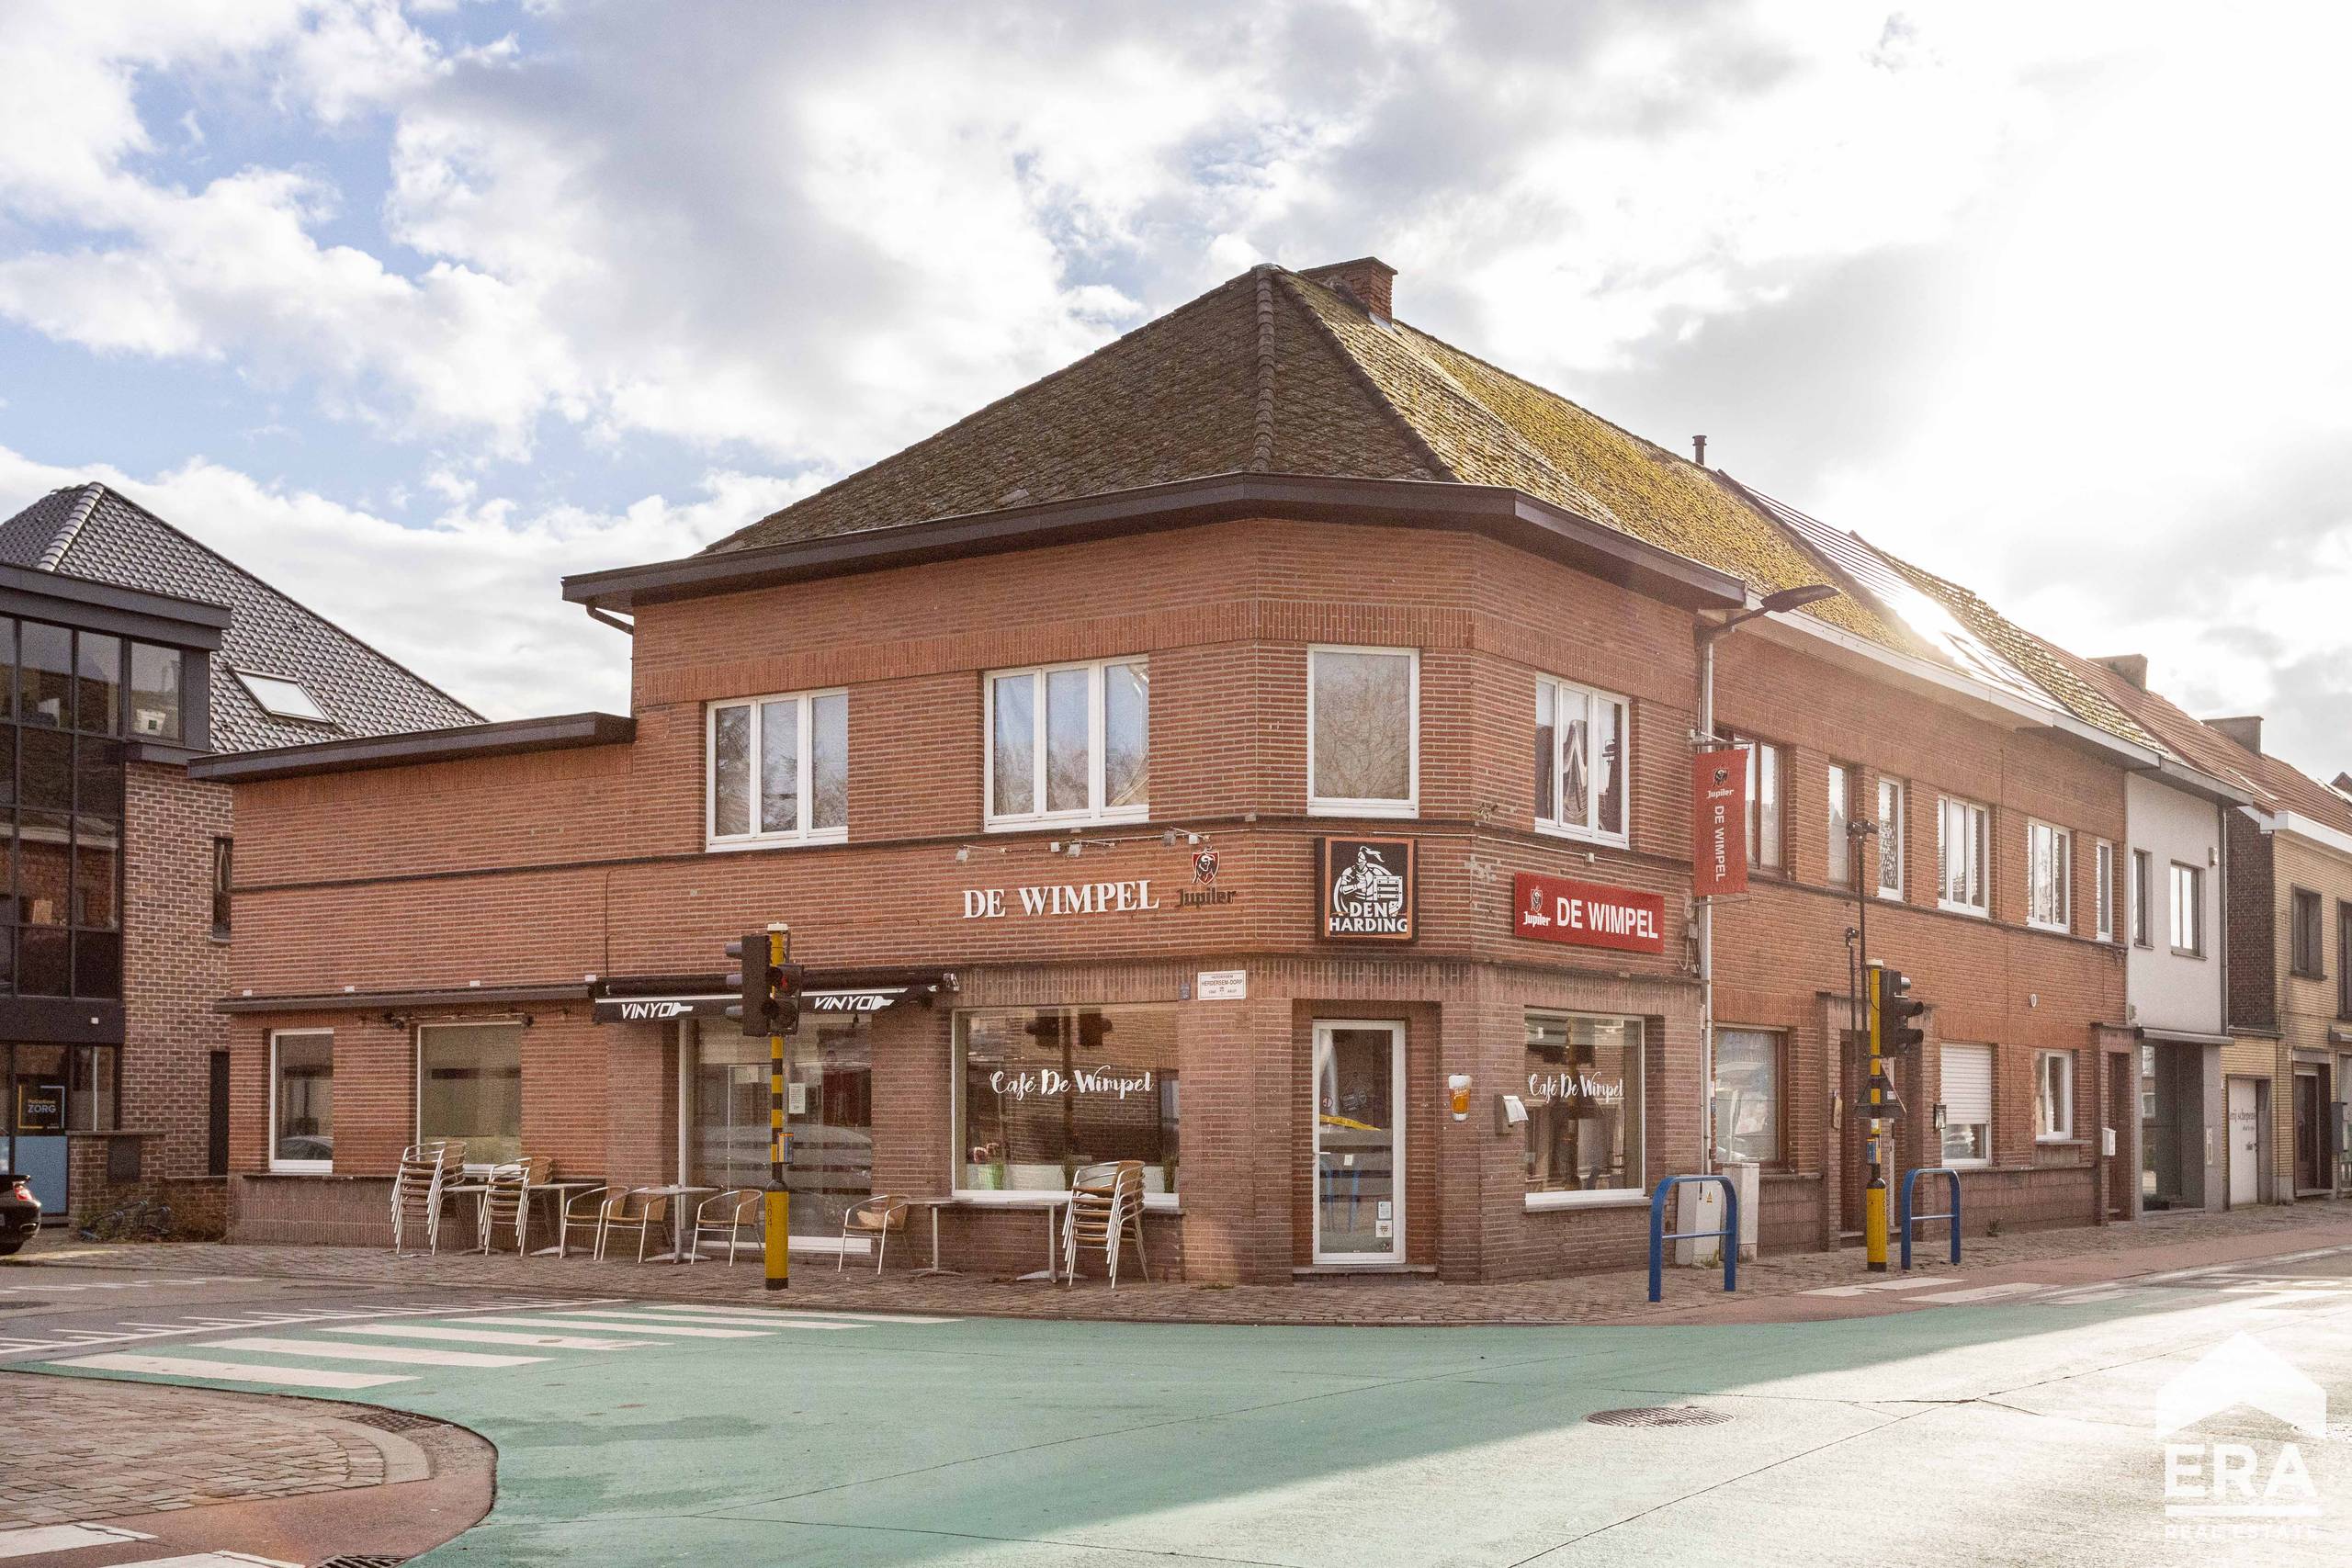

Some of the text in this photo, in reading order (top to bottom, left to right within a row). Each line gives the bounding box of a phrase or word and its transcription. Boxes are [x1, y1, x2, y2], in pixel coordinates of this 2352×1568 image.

[1706, 789, 1735, 799] Jupiler
[1713, 806, 1727, 883] DE WIMPEL
[962, 879, 1159, 919] DE WIMPEL
[1175, 887, 1238, 908] Jupiler
[1350, 901, 1388, 918] DEN
[1556, 897, 1658, 940] DE WIMPEL
[1329, 918, 1408, 932] HARDING
[1521, 910, 1552, 928] Jupiler
[621, 1003, 673, 1019] VINYO
[814, 995, 873, 1010] VINYO
[989, 1065, 1154, 1101] Café De Wimpel
[1528, 1071, 1624, 1104] Café De Wimpel
[28, 1104, 57, 1113] ZORG
